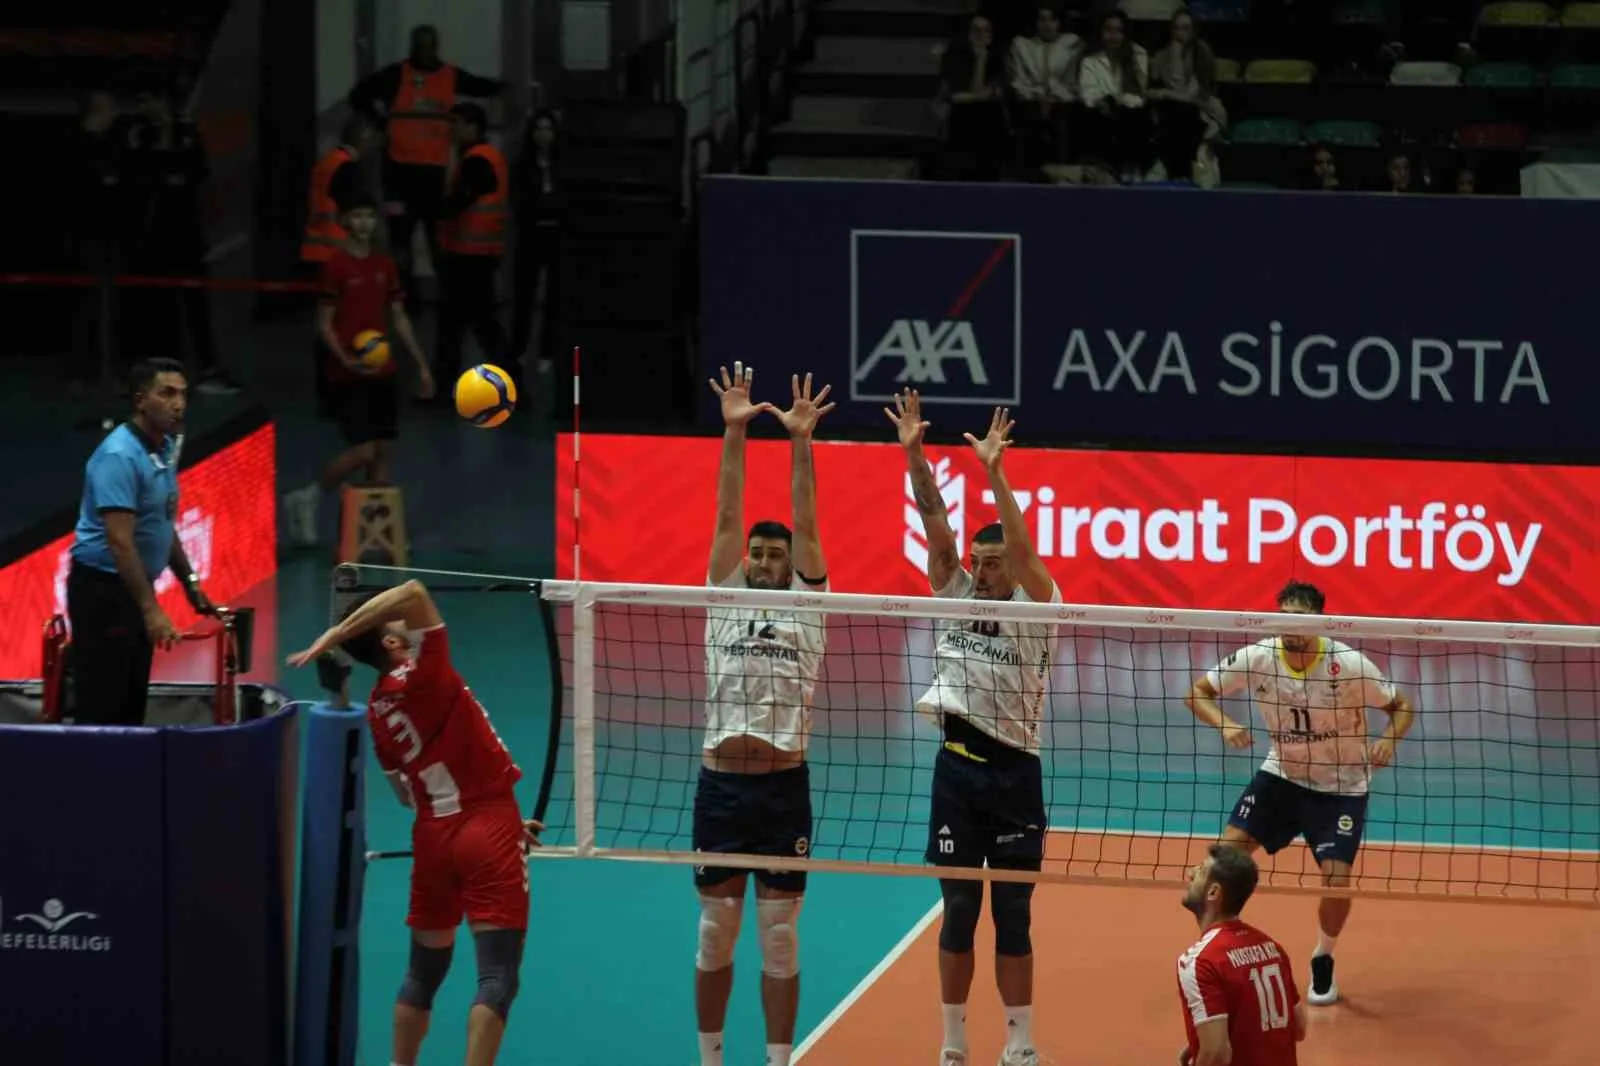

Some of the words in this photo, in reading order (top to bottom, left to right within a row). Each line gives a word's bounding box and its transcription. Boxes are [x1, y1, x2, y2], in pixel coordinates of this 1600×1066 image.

[853, 319, 990, 386] AXA
[1052, 328, 1198, 395] AXA
[1217, 320, 1550, 405] SİGORTA
[1248, 497, 1543, 587] Portföy
[386, 709, 422, 764] 3
[938, 838, 954, 854] 10
[1248, 963, 1288, 1032] 10
